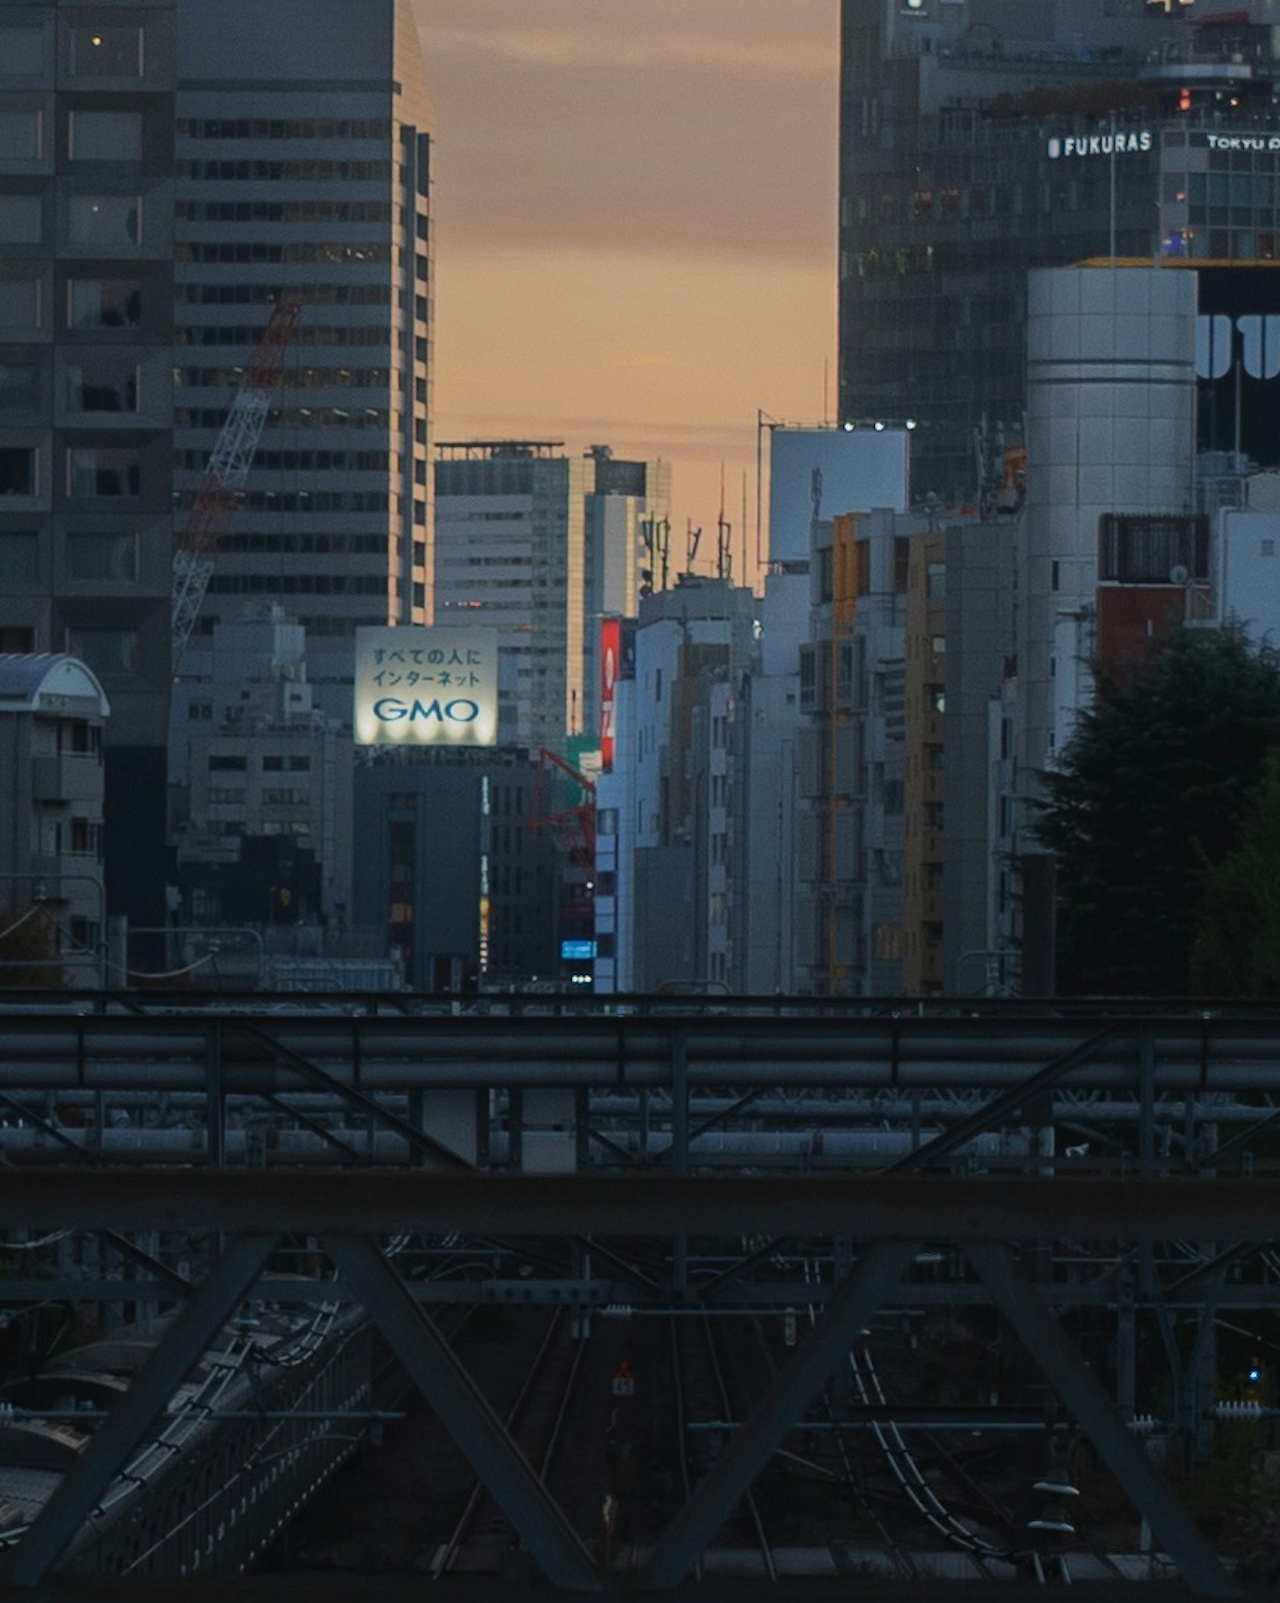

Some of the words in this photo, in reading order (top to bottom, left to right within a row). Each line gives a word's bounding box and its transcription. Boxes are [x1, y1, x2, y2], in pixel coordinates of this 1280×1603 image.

[1064, 132, 1152, 157] FUKURAS
[1206, 135, 1265, 150] TOKYU
[373, 647, 482, 665] すべての人に
[373, 670, 480, 687] インターネット
[373, 698, 479, 722] GMO
